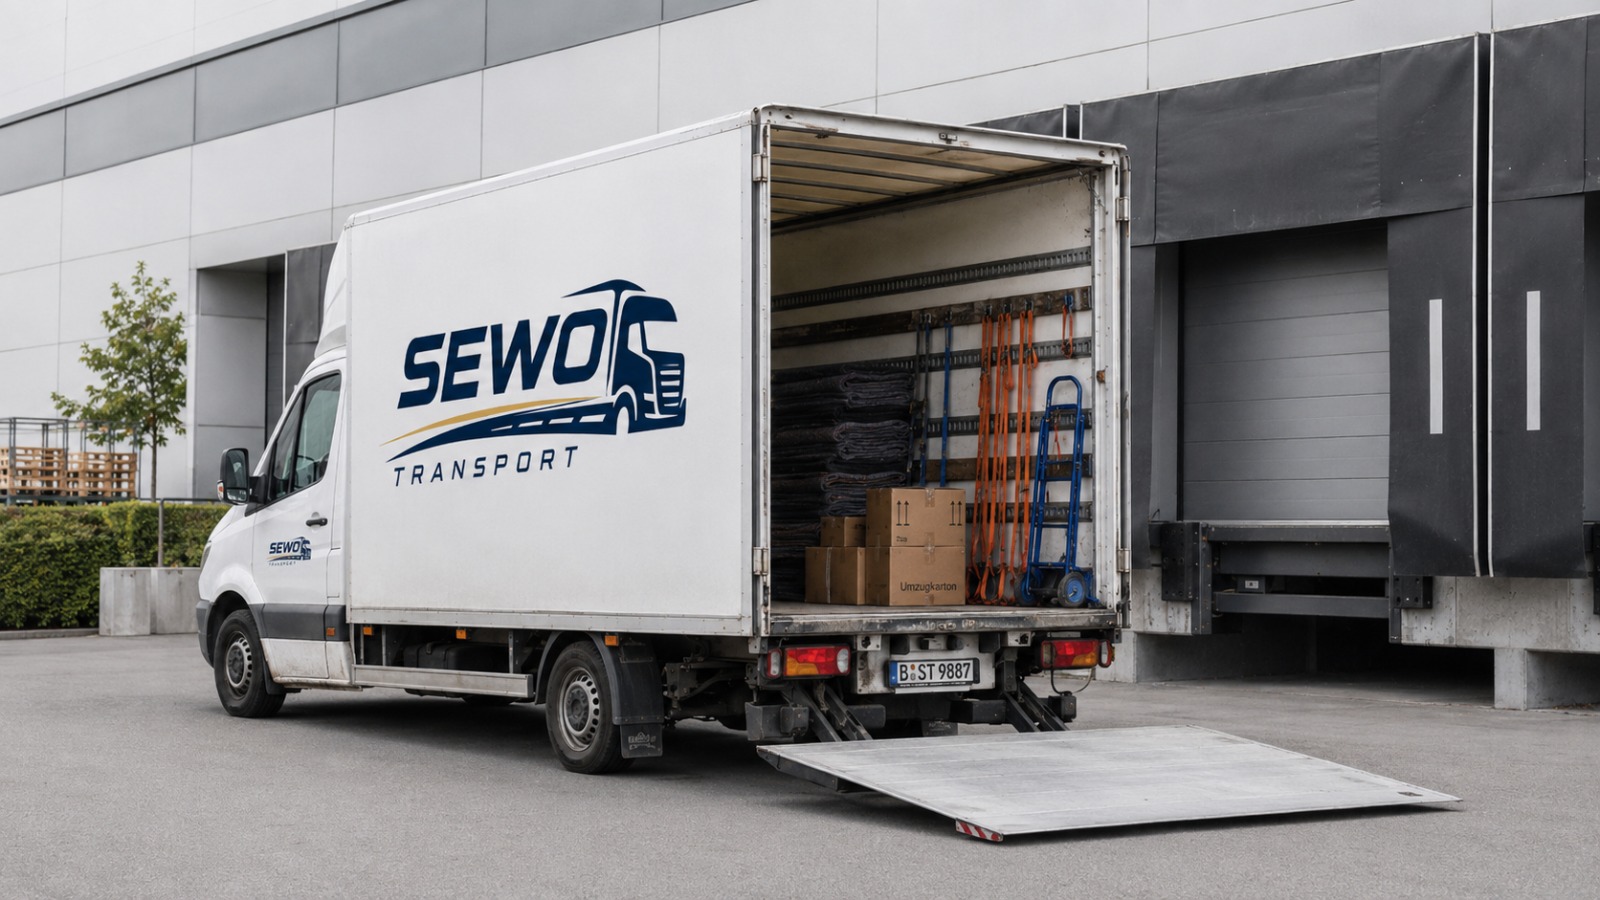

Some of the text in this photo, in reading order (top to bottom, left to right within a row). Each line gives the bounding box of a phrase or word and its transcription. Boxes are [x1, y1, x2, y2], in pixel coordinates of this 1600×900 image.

[397, 308, 608, 409] SEWO
[394, 446, 578, 487] TRANSPORT
[269, 541, 301, 554] SEWO
[900, 582, 957, 593] Umzugkarton
[900, 662, 971, 681] B ST 9887
